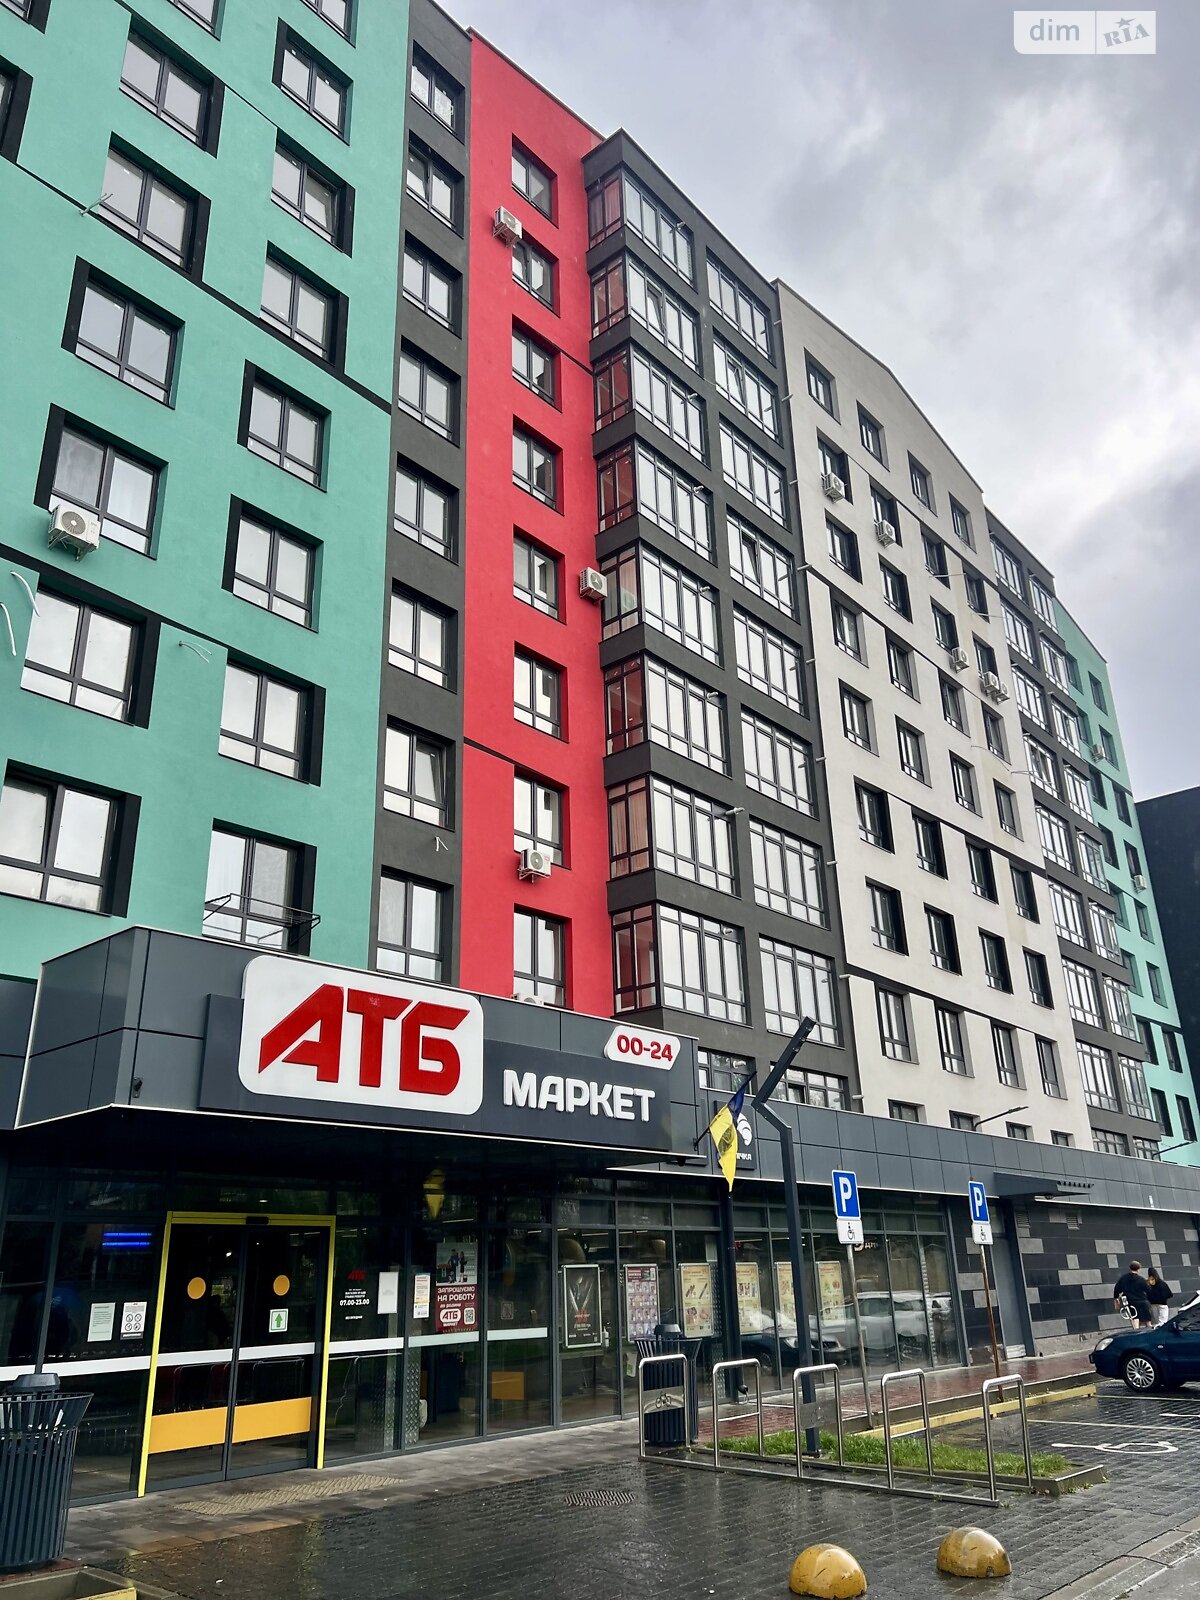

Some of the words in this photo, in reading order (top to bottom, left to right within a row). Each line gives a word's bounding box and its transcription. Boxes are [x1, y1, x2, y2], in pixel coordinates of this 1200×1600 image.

[258, 983, 470, 1095] АТБ
[616, 1034, 674, 1062] 00-24
[503, 1069, 656, 1122] МАРКЕТ
[838, 1176, 852, 1213] P
[973, 1186, 983, 1217] P
[437, 1294, 448, 1302] НА
[448, 1293, 475, 1301] РОБОТУ
[442, 1310, 458, 1320] АТБ
